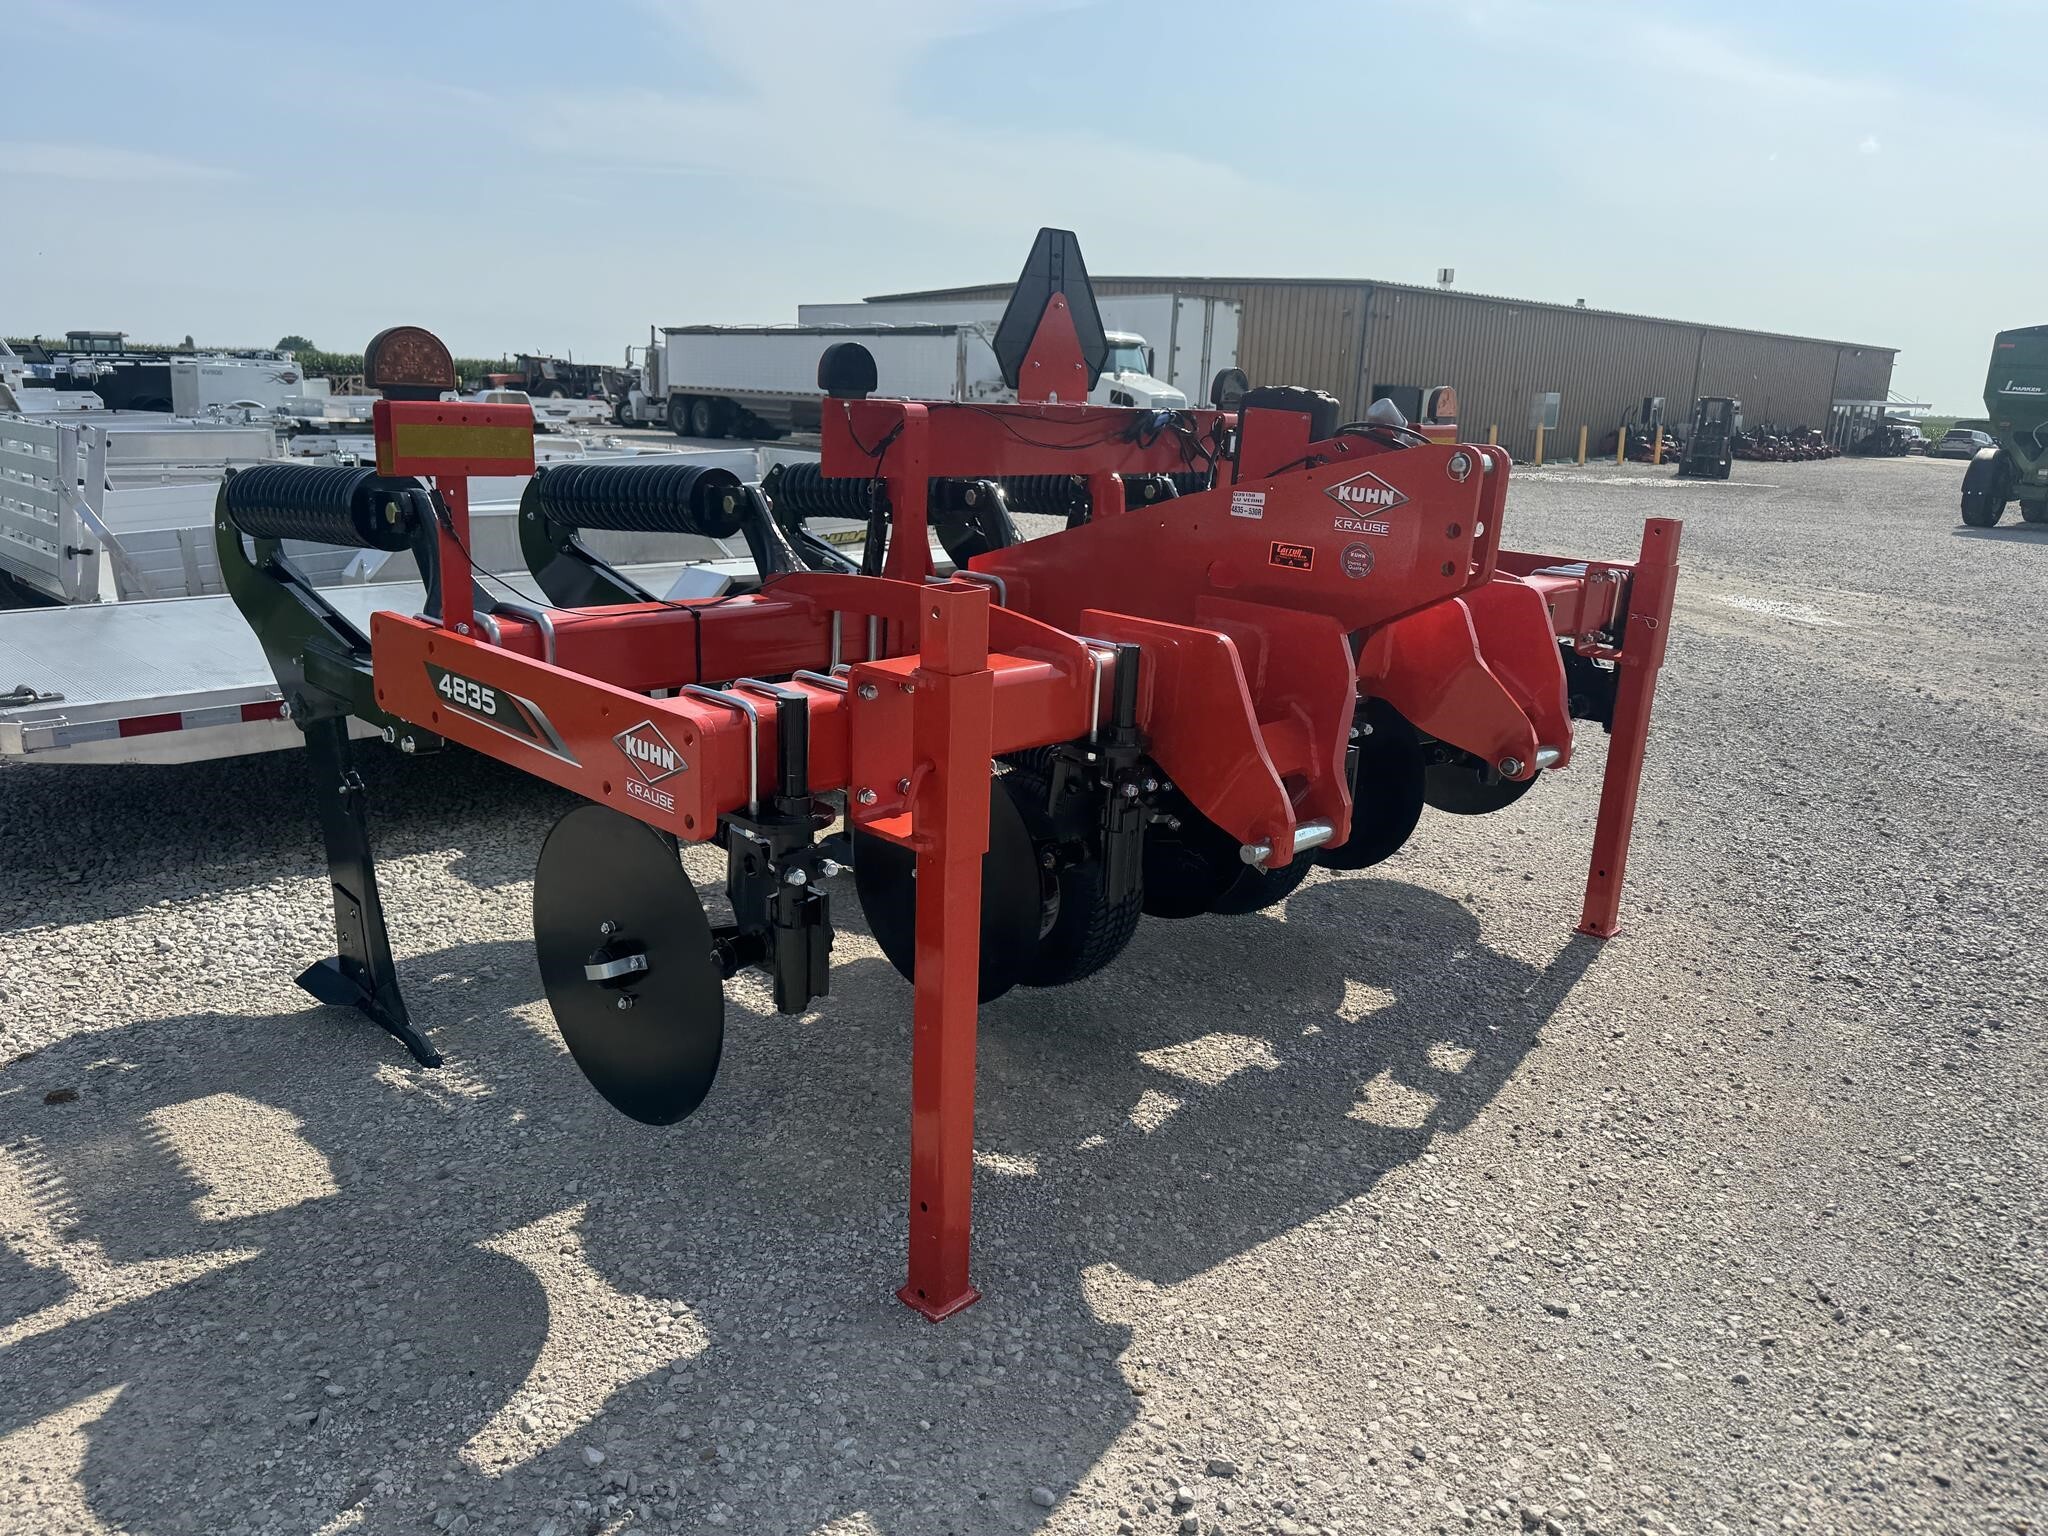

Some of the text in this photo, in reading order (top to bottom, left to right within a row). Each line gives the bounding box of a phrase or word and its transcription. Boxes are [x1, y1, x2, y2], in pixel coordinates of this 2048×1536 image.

[1338, 485, 1395, 505] KUHN
[1334, 519, 1390, 533] KRAUSE
[439, 673, 496, 715] 4835
[625, 734, 675, 771] KUHN
[626, 781, 675, 810] KRAUSE
